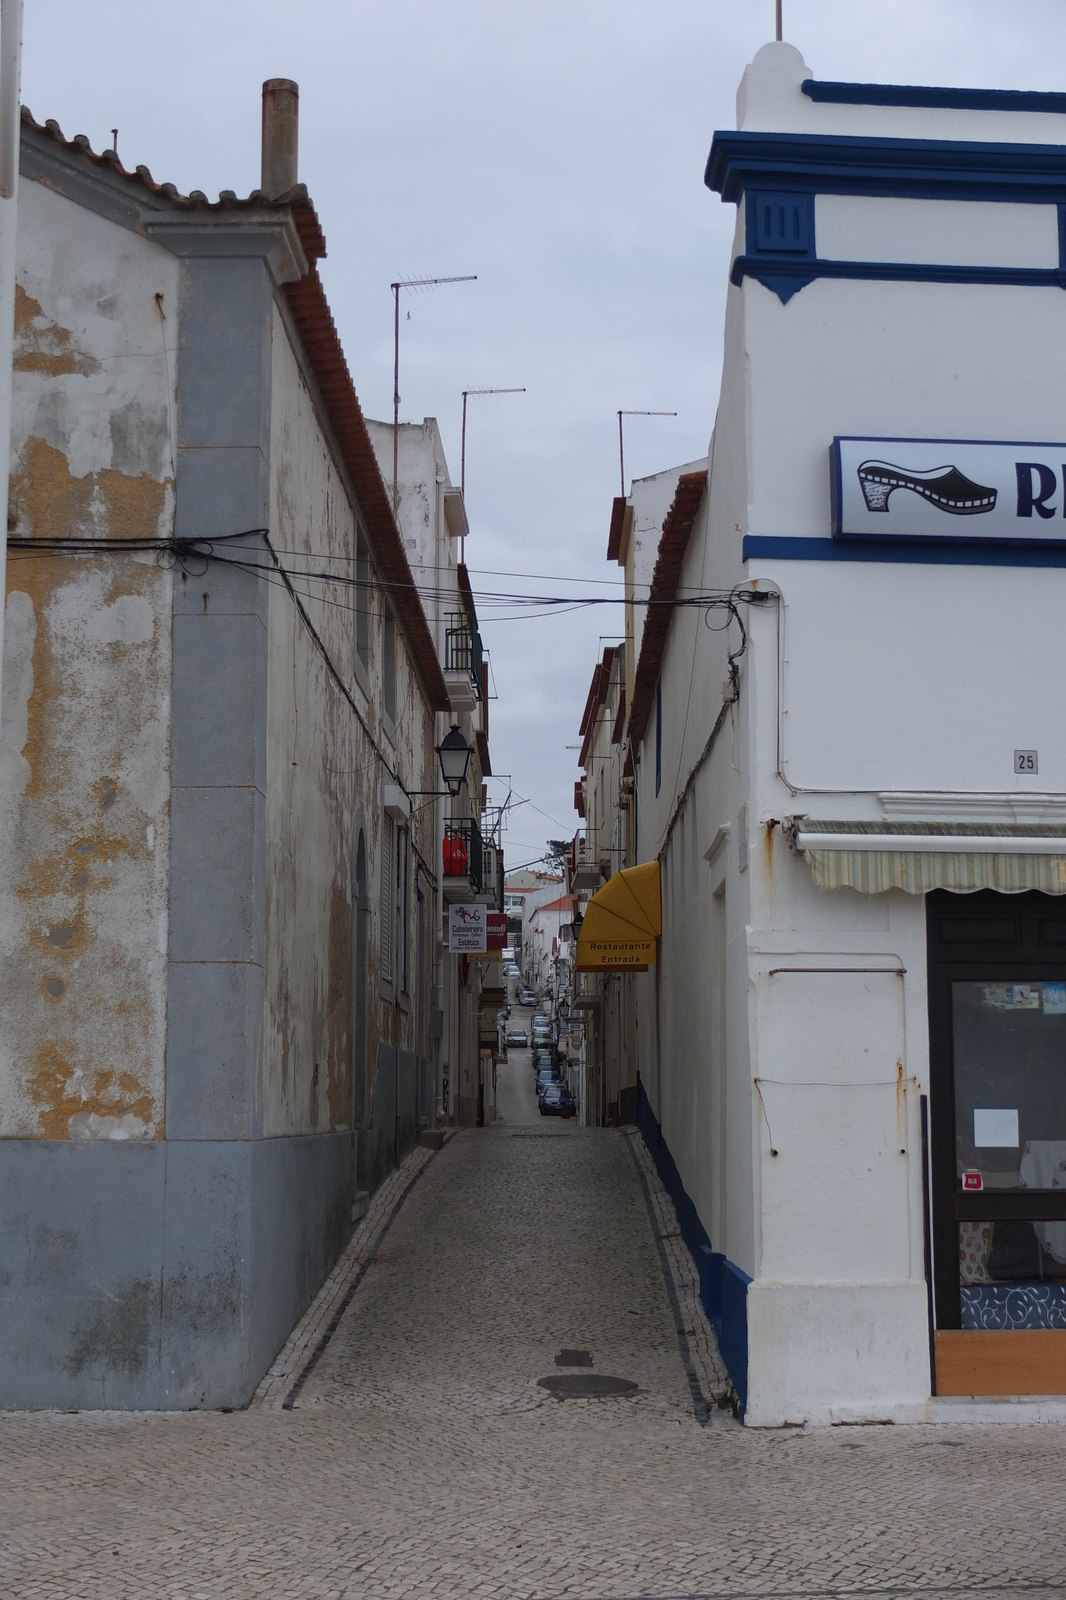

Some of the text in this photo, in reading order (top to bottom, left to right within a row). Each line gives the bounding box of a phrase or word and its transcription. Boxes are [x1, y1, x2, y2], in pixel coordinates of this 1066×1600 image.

[1015, 462, 1066, 519] R
[1018, 755, 1034, 769] 25
[452, 924, 484, 933] Cabeleireiro
[458, 938, 480, 946] Estética
[601, 955, 640, 963] Entrada
